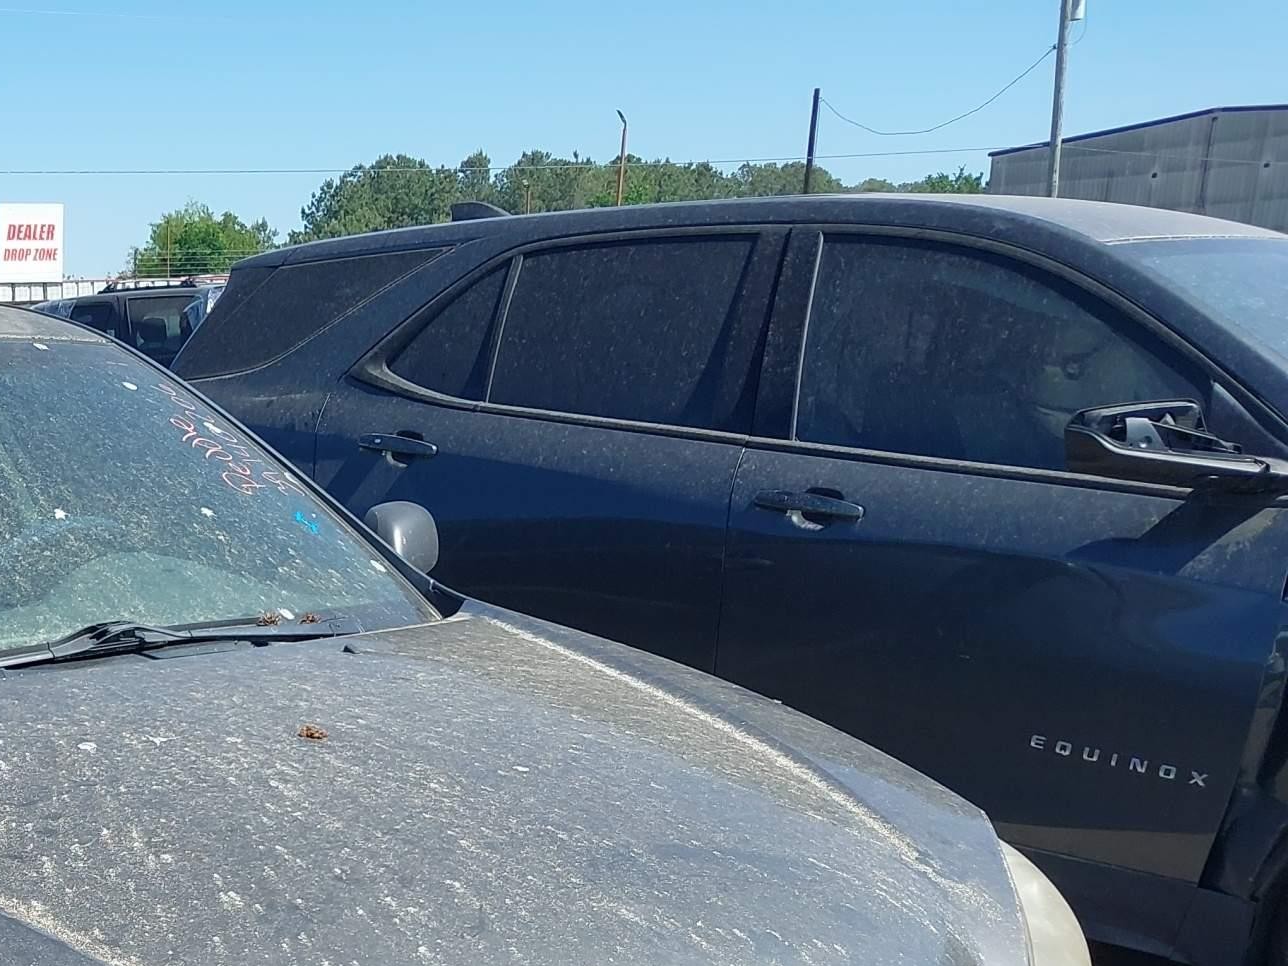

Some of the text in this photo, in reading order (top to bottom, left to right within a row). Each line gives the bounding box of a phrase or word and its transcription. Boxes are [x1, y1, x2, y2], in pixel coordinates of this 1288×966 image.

[6, 223, 55, 241] DEALER
[3, 247, 58, 262] DROP ZONE
[1029, 734, 1209, 788] EQUINOX
